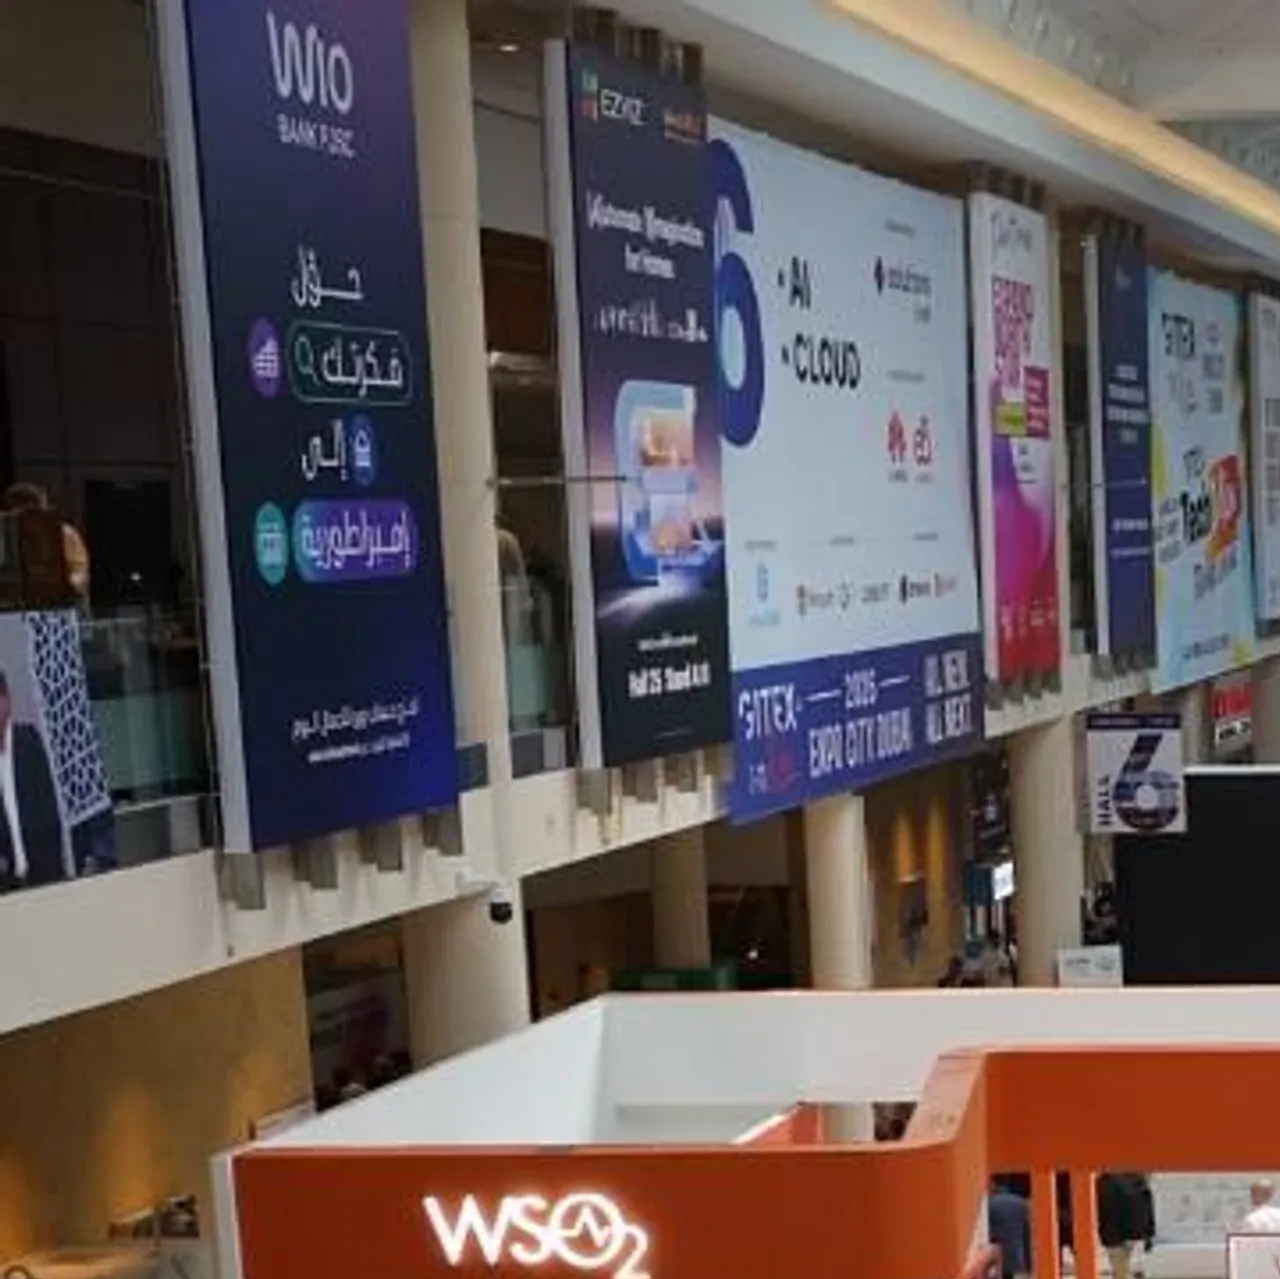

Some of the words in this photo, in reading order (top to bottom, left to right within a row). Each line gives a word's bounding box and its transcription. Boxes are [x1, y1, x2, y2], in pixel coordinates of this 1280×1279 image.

[793, 333, 862, 389] CLOUD
[738, 682, 798, 740] GITEX
[1097, 774, 1112, 827] HALL
[1112, 733, 1181, 830] 6
